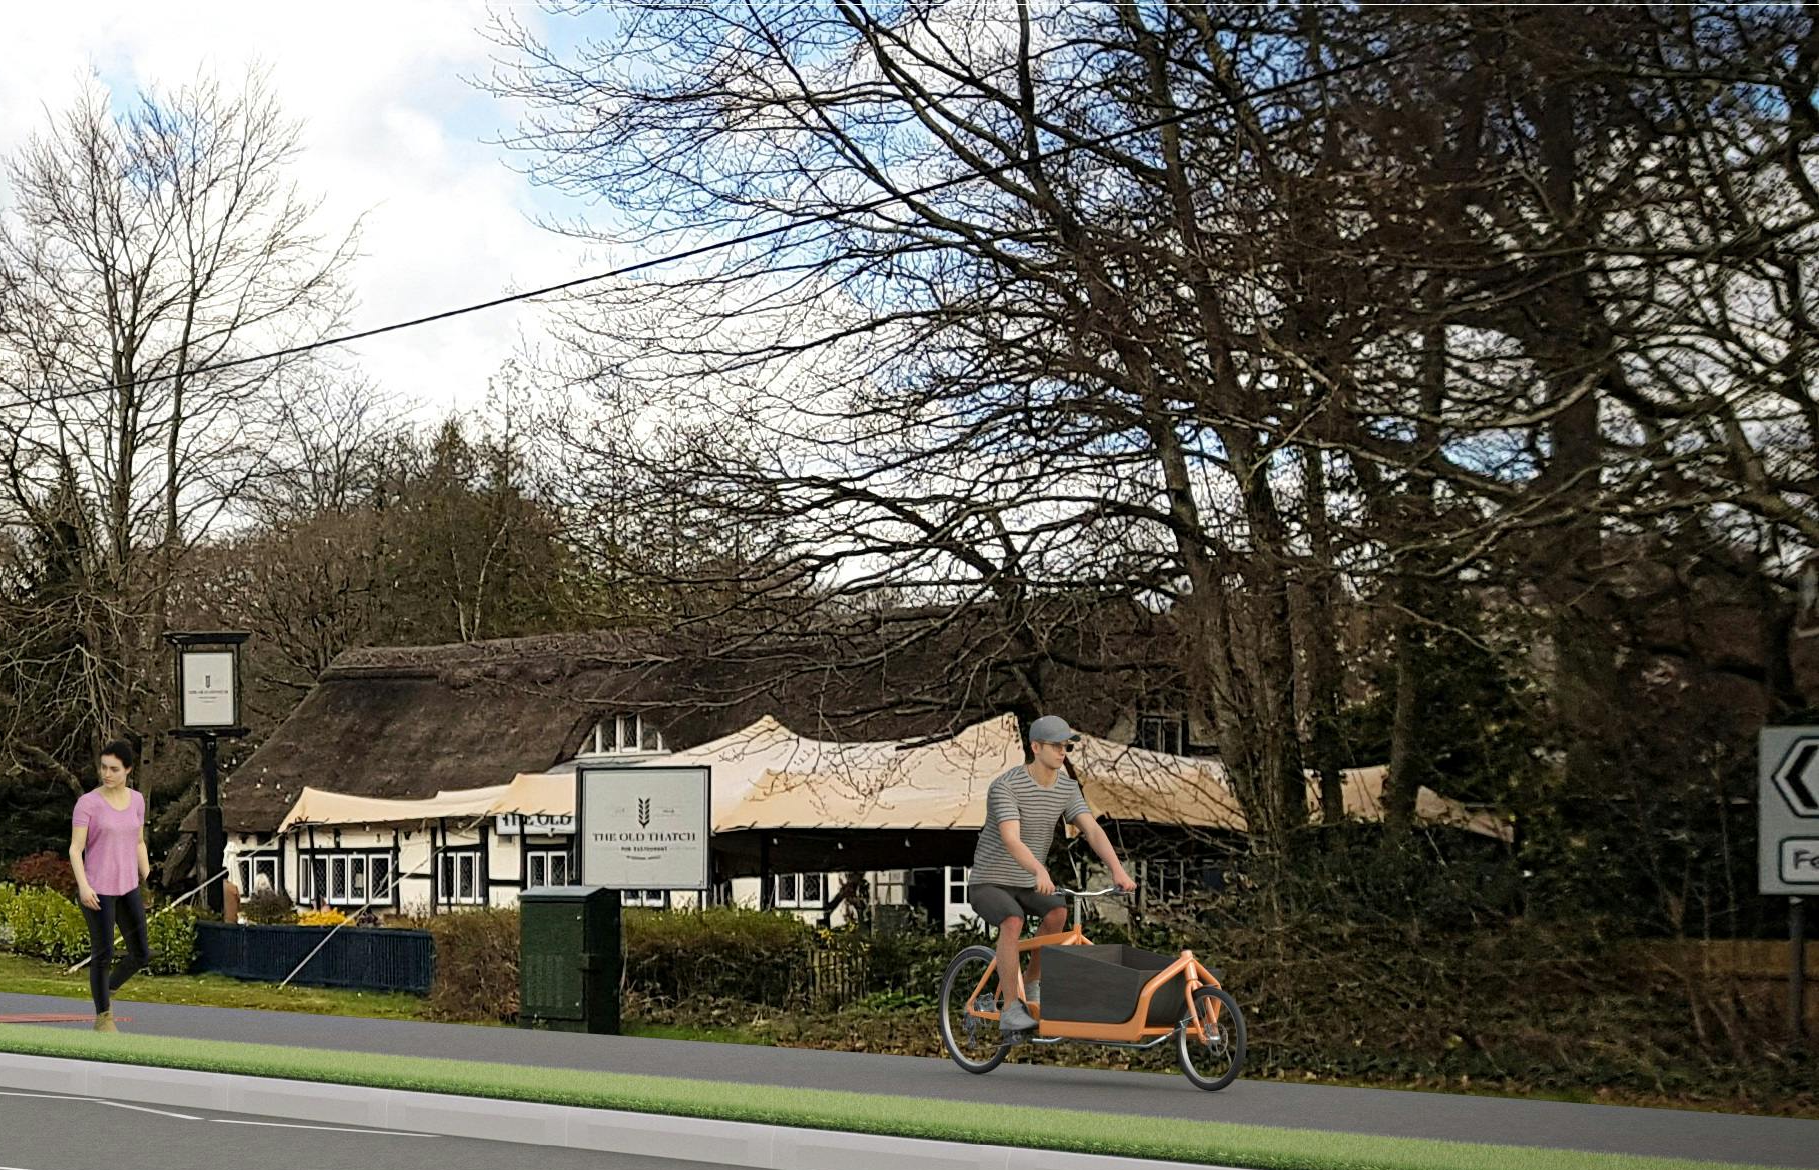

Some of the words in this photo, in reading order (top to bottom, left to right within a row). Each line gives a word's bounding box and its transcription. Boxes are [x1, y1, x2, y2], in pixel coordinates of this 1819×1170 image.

[592, 832, 618, 841] THE
[619, 832, 645, 841] OLD
[648, 832, 696, 841] THATCH
